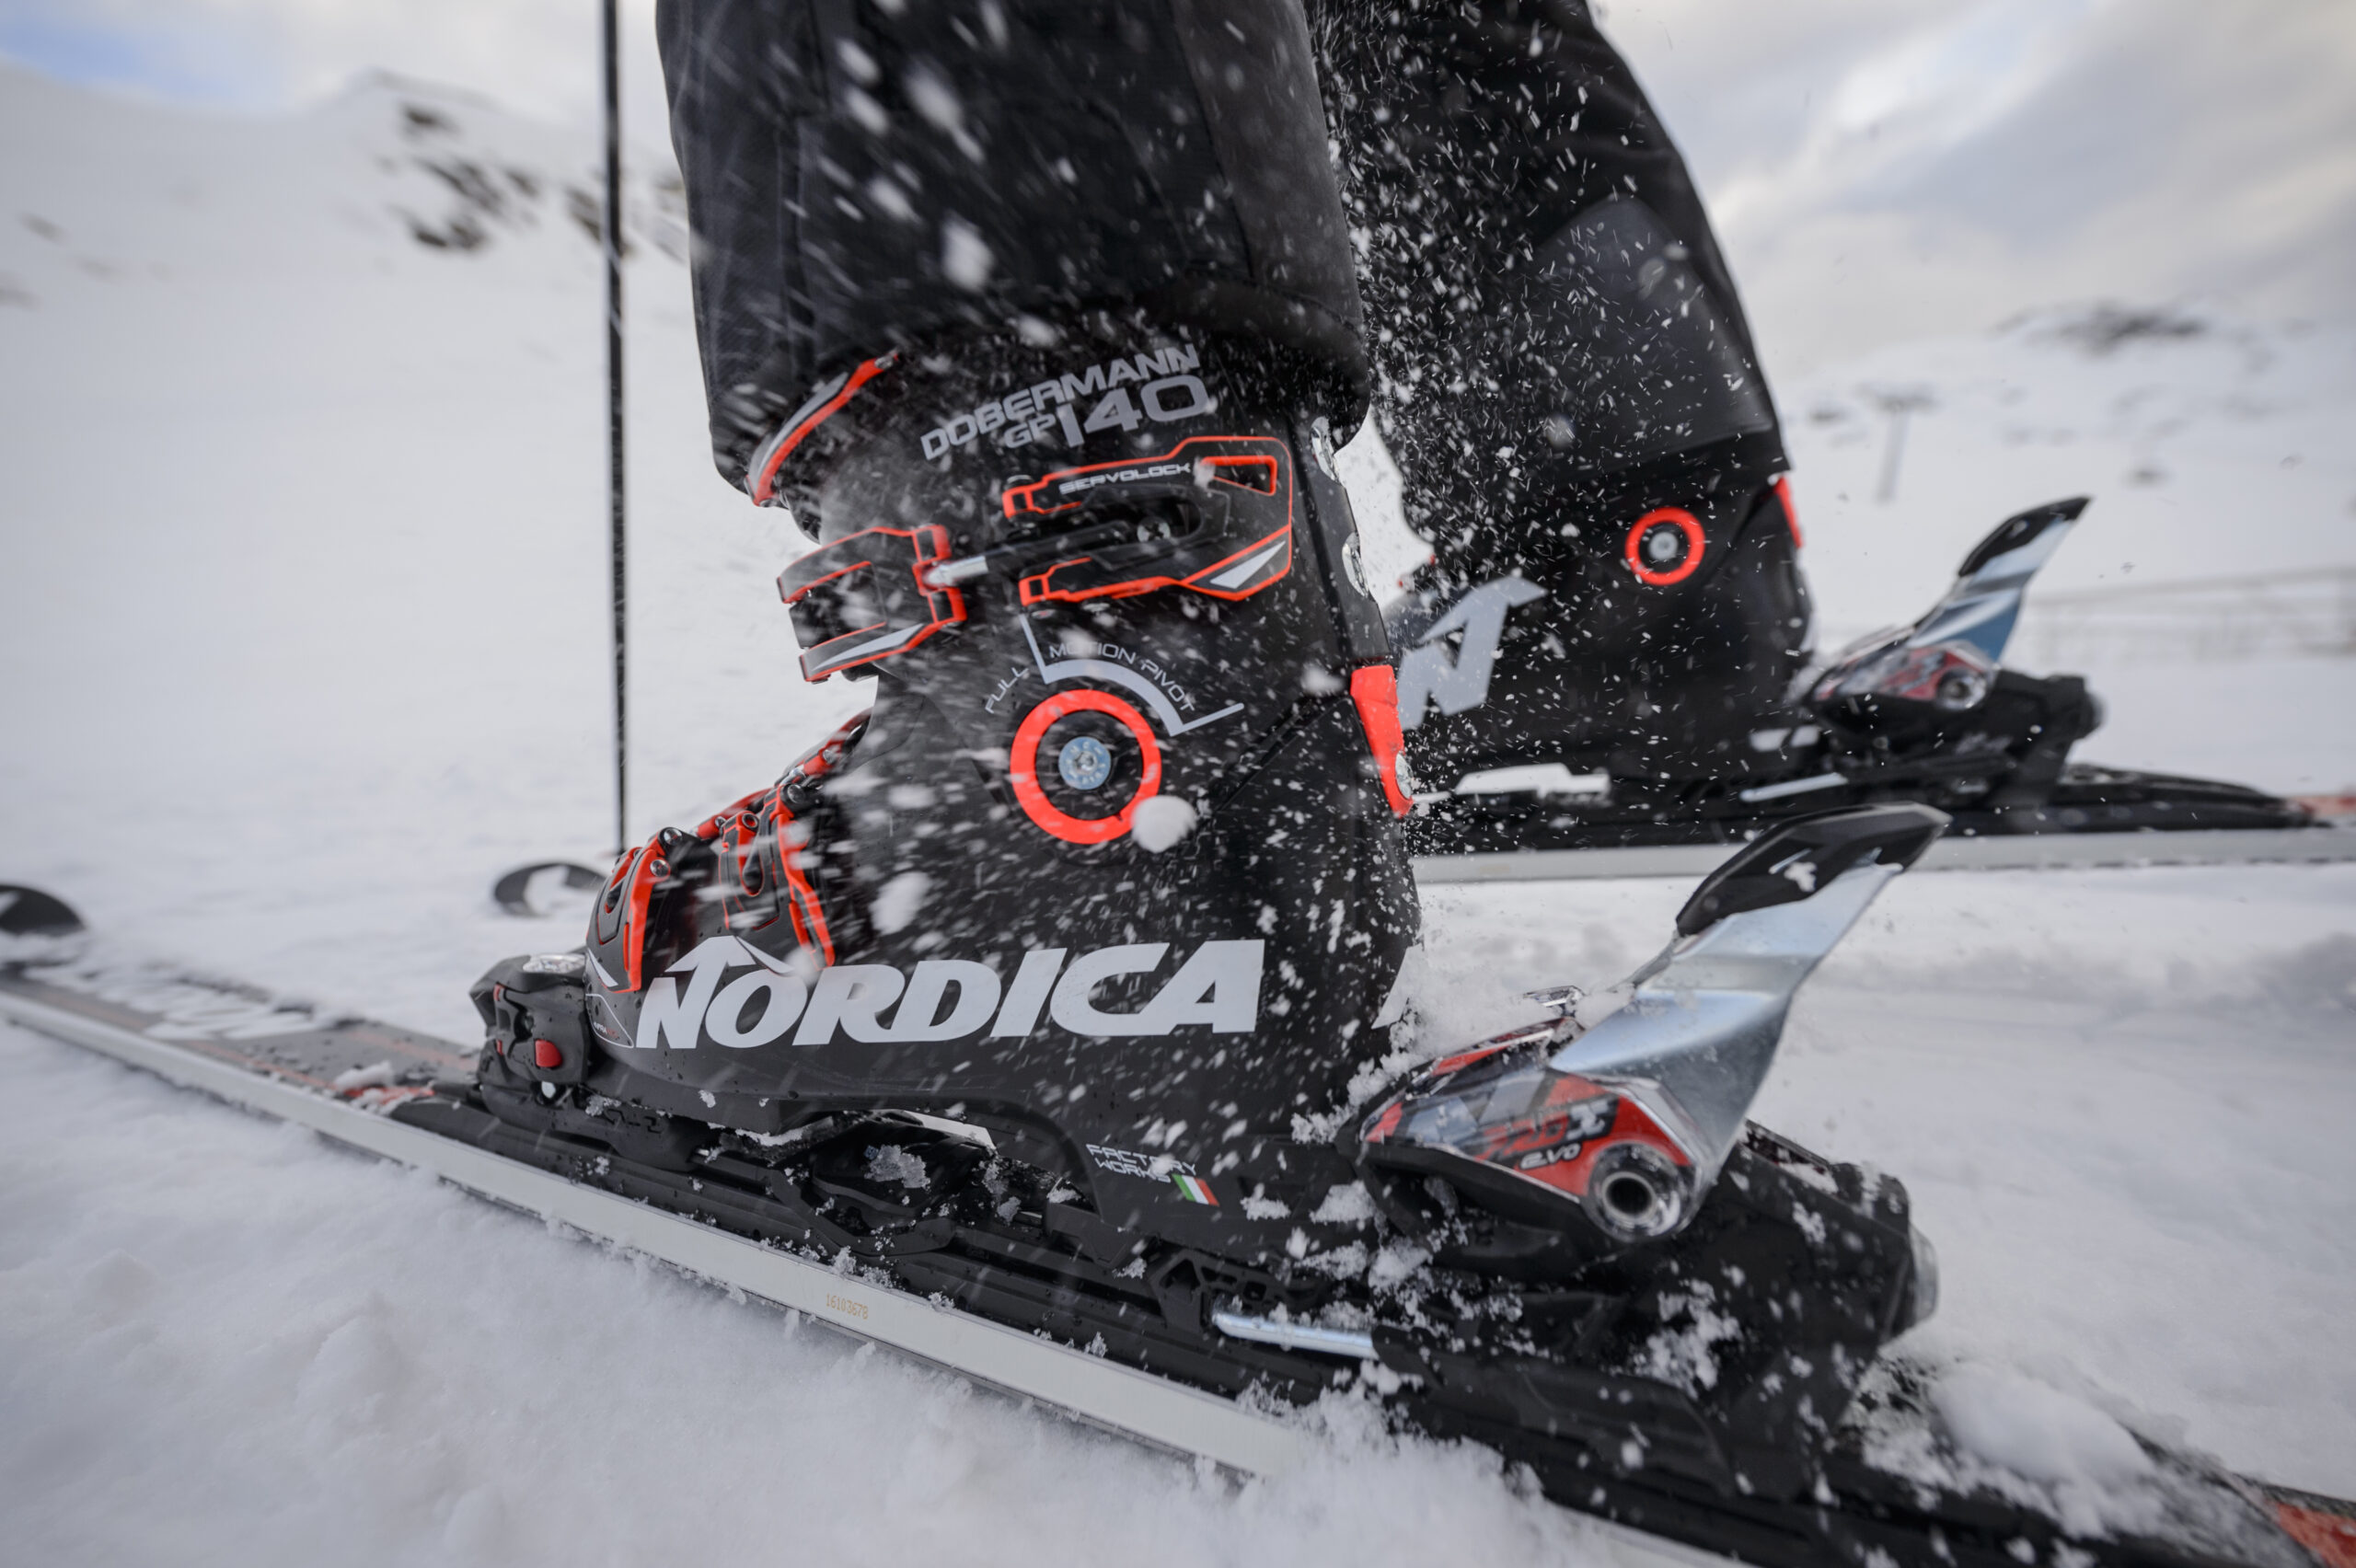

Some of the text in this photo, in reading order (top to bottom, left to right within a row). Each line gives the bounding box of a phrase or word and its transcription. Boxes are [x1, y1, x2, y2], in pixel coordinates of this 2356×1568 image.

[921, 343, 1200, 460] DOBERMANN
[1003, 375, 1210, 449] GP 140
[1058, 462, 1191, 495] SERVOLOCK
[984, 667, 1029, 714] FULL
[1140, 659, 1195, 712] PIVOT
[636, 936, 1265, 1048] NORDICA
[1085, 1144, 1196, 1176] FACTRY
